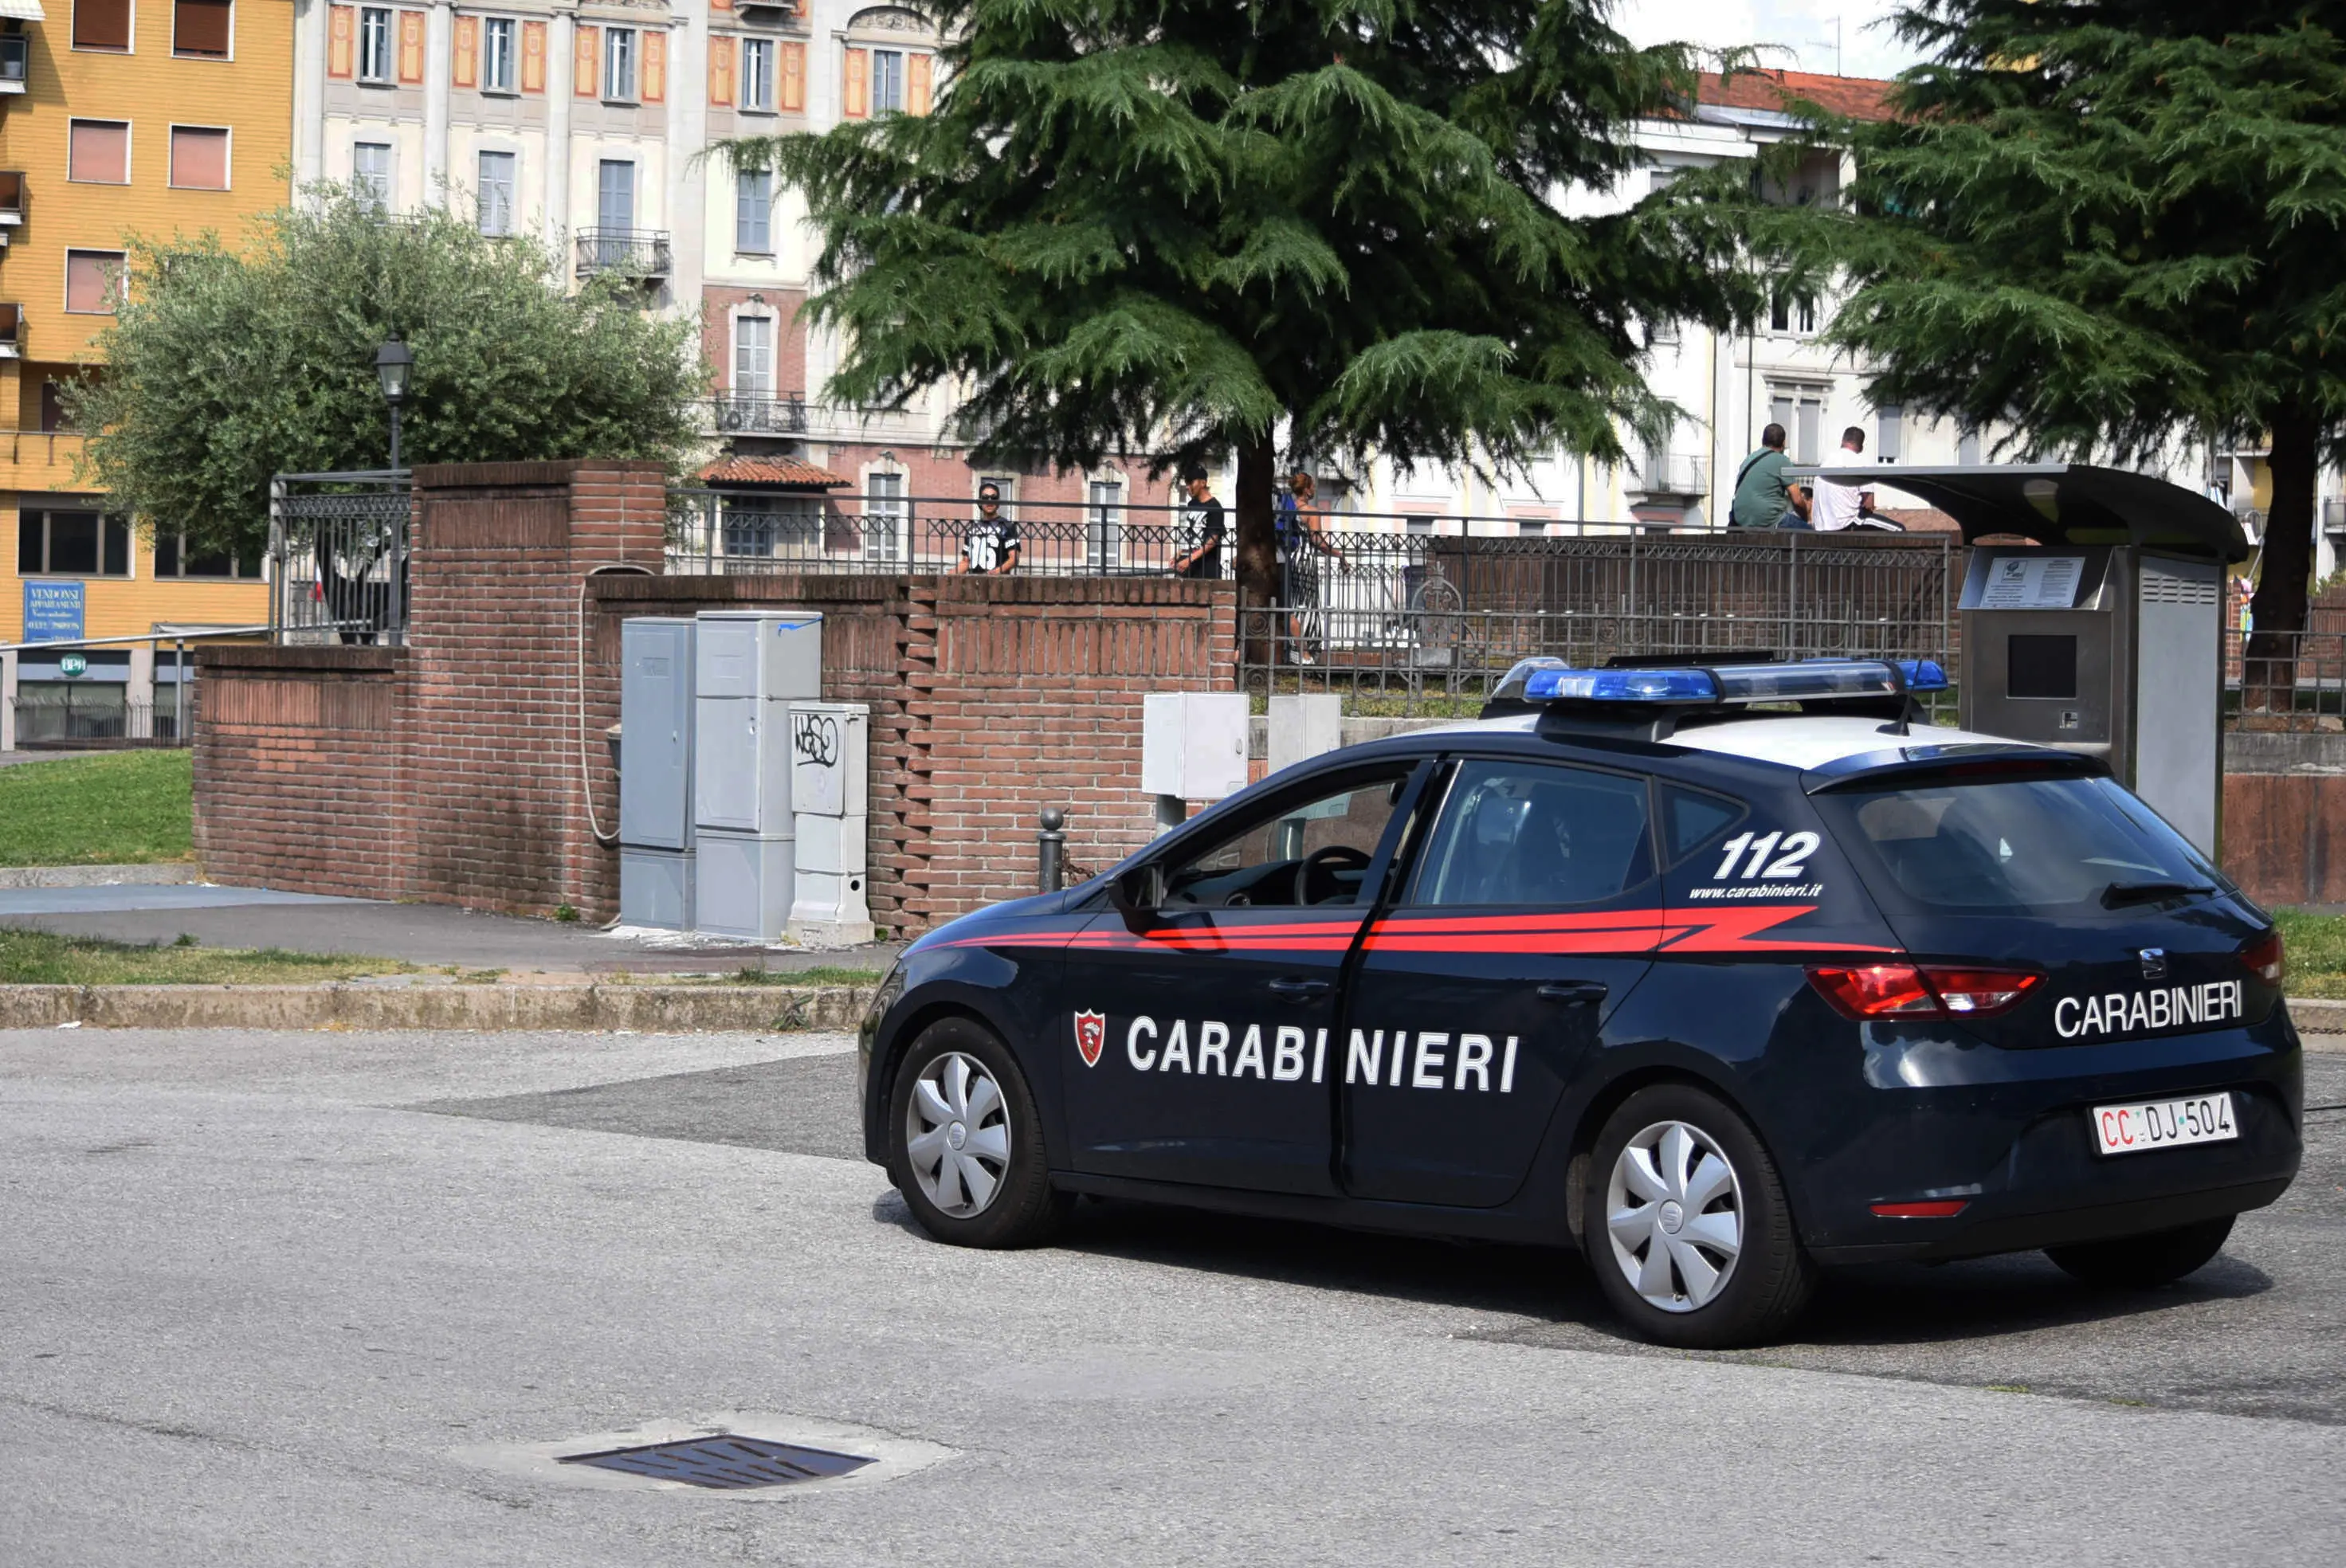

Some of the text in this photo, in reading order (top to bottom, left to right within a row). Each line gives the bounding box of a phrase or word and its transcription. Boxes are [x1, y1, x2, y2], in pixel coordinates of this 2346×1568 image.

[1713, 831, 1821, 880] 112
[1689, 884, 1823, 900] www.carabinieri.it
[2054, 980, 2242, 1037] CARABINIERI
[2101, 1111, 2134, 1147] CC
[2185, 1097, 2230, 1137] 504
